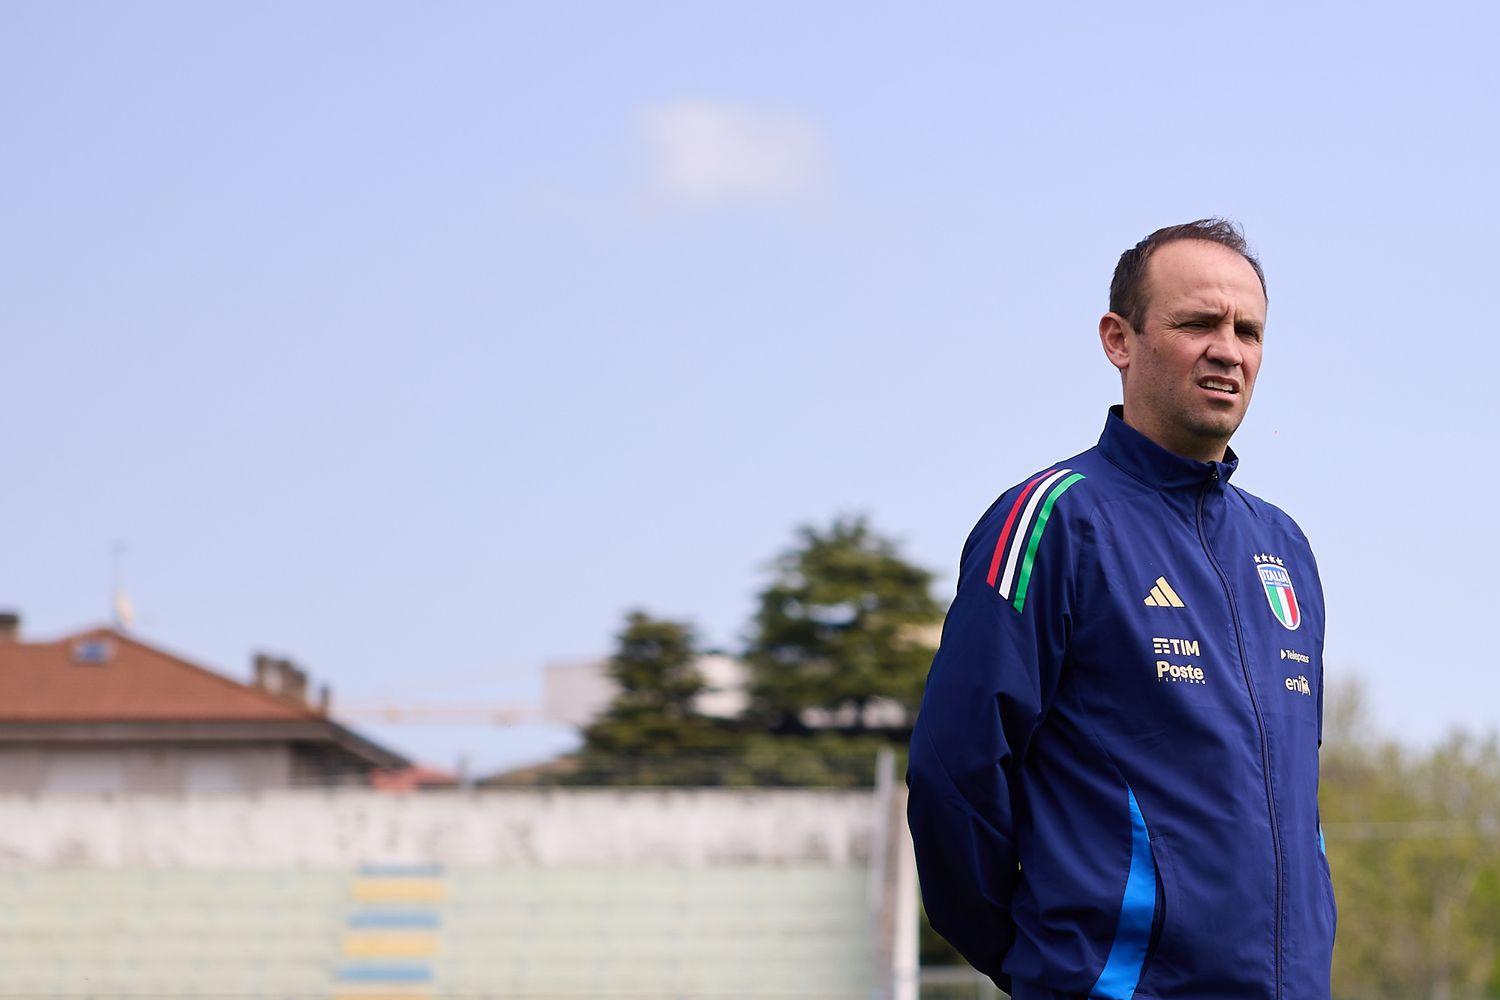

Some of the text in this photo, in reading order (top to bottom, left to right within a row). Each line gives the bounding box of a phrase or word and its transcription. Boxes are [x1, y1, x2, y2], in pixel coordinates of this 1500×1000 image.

[1260, 569, 1289, 585] ITALIA
[1170, 639, 1200, 656] TIM
[1286, 650, 1310, 664] Telepass
[1156, 661, 1204, 680] Poste
[1285, 675, 1302, 692] eni
